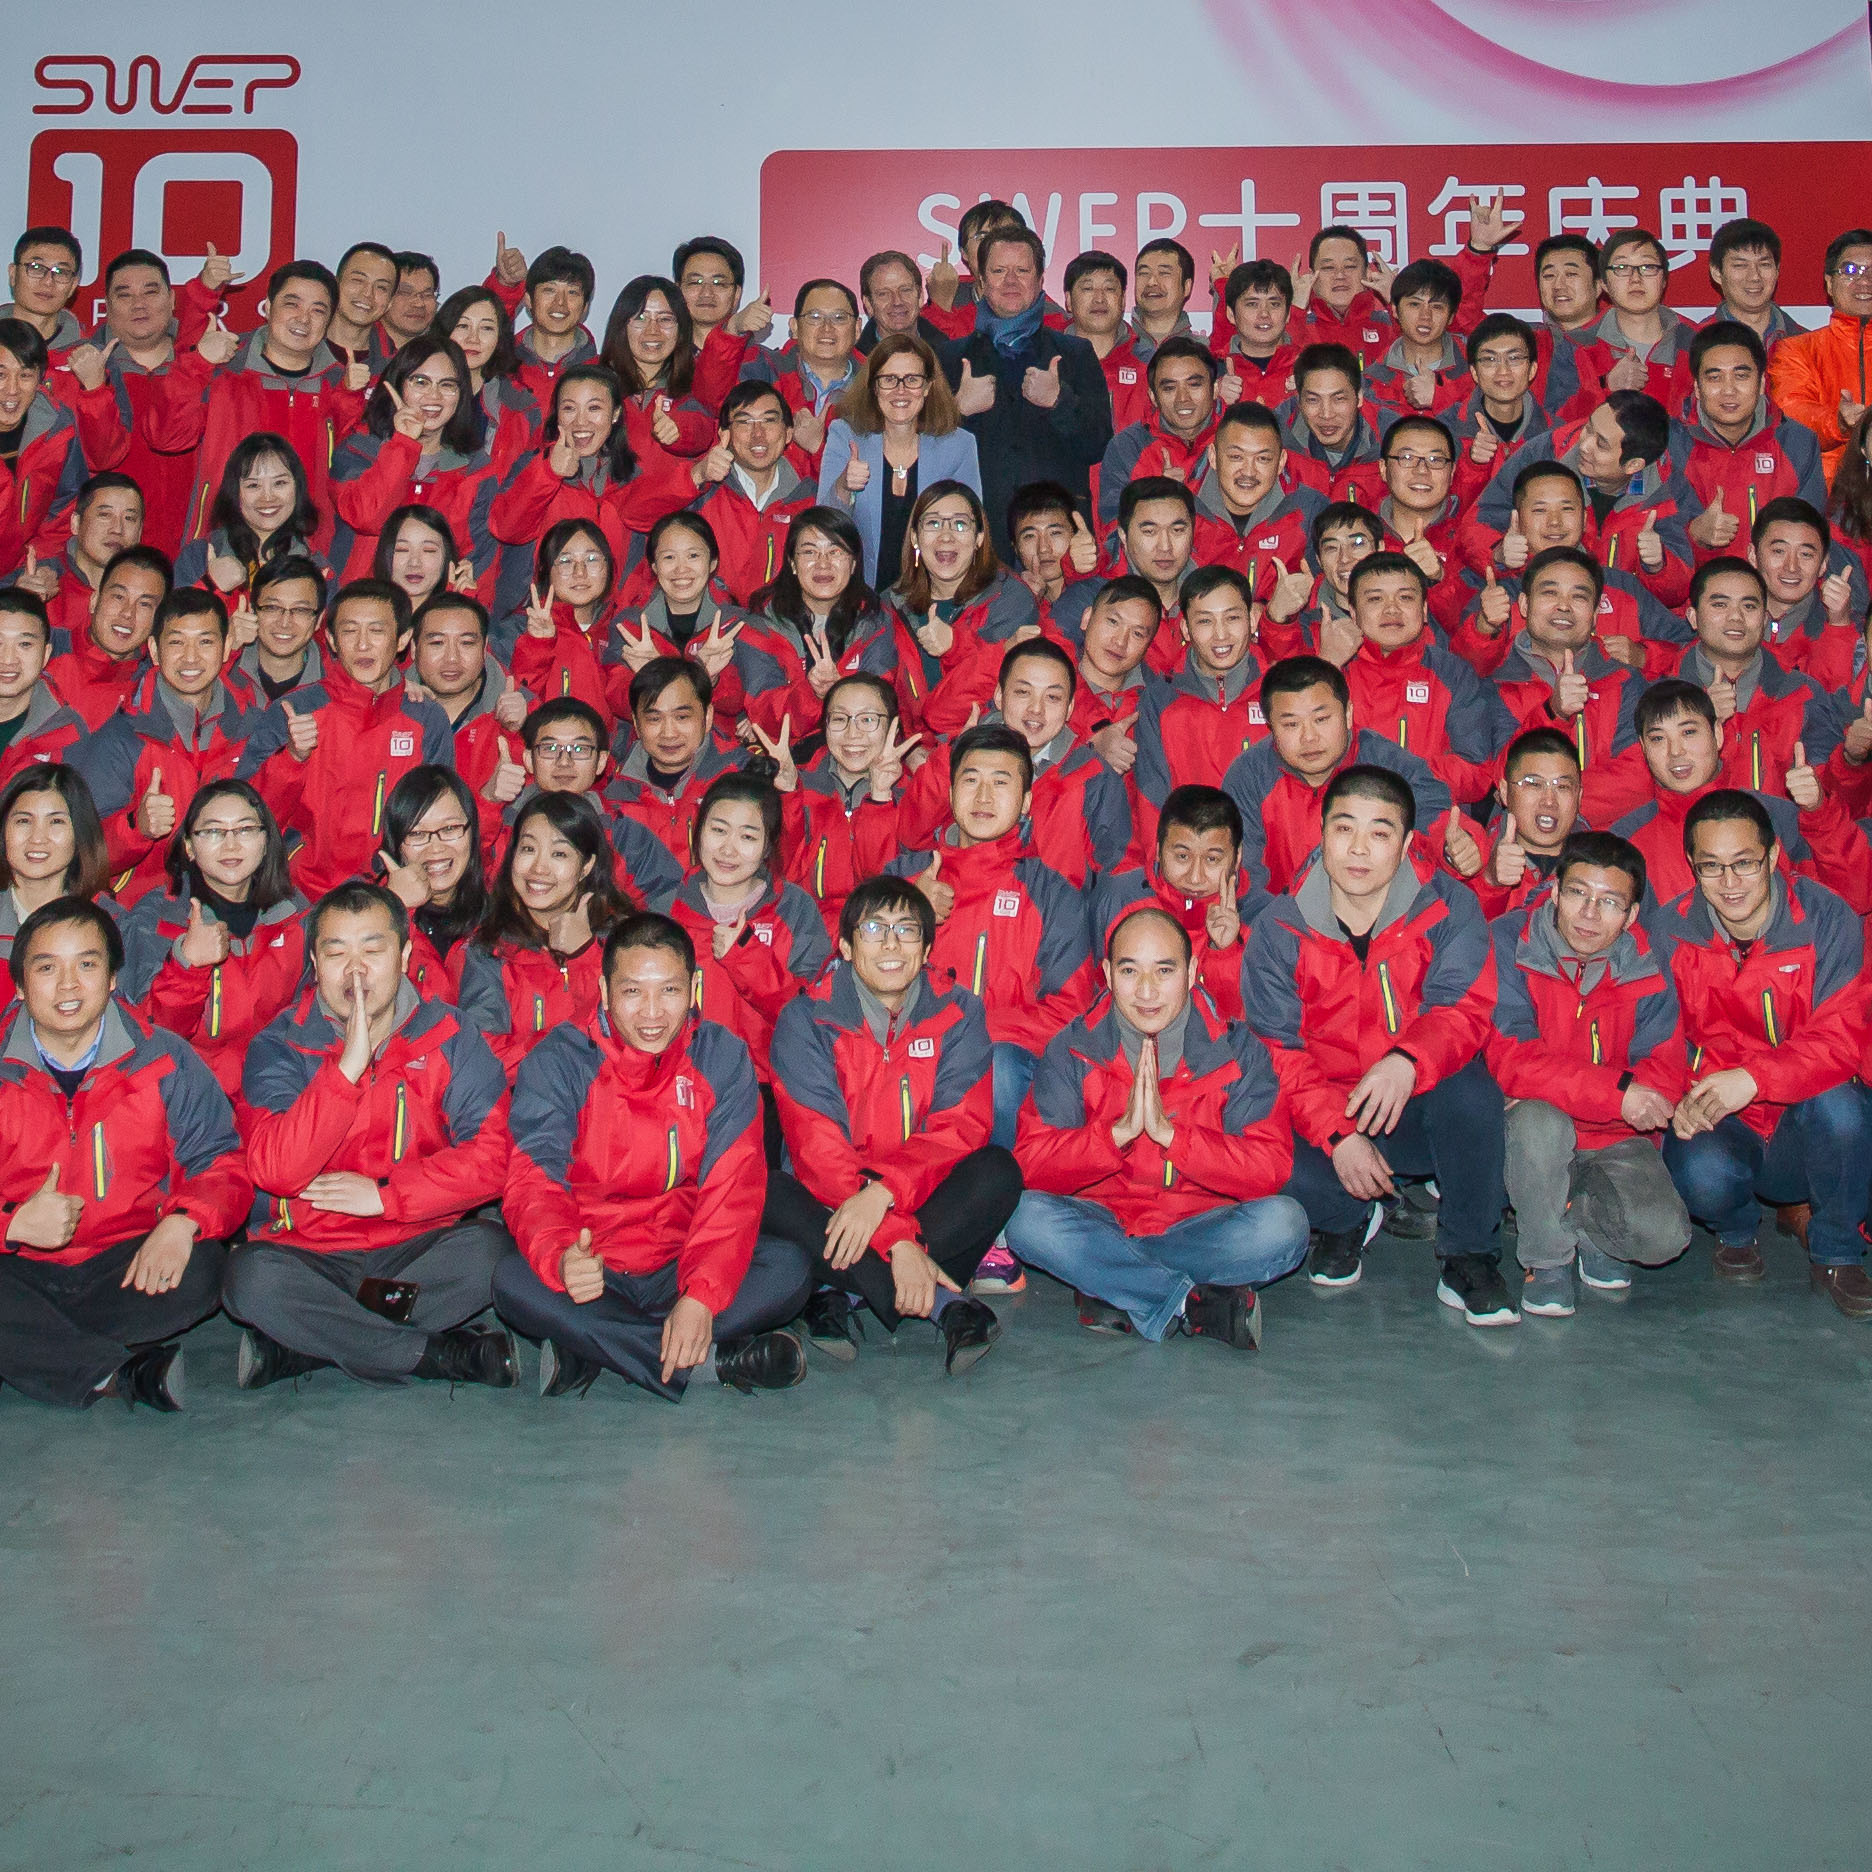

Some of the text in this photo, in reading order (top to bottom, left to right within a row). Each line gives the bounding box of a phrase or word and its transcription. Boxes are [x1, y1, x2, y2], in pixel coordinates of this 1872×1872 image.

[31, 54, 302, 115] SWEP
[53, 151, 274, 288] 10
[998, 900, 1016, 911] 10
